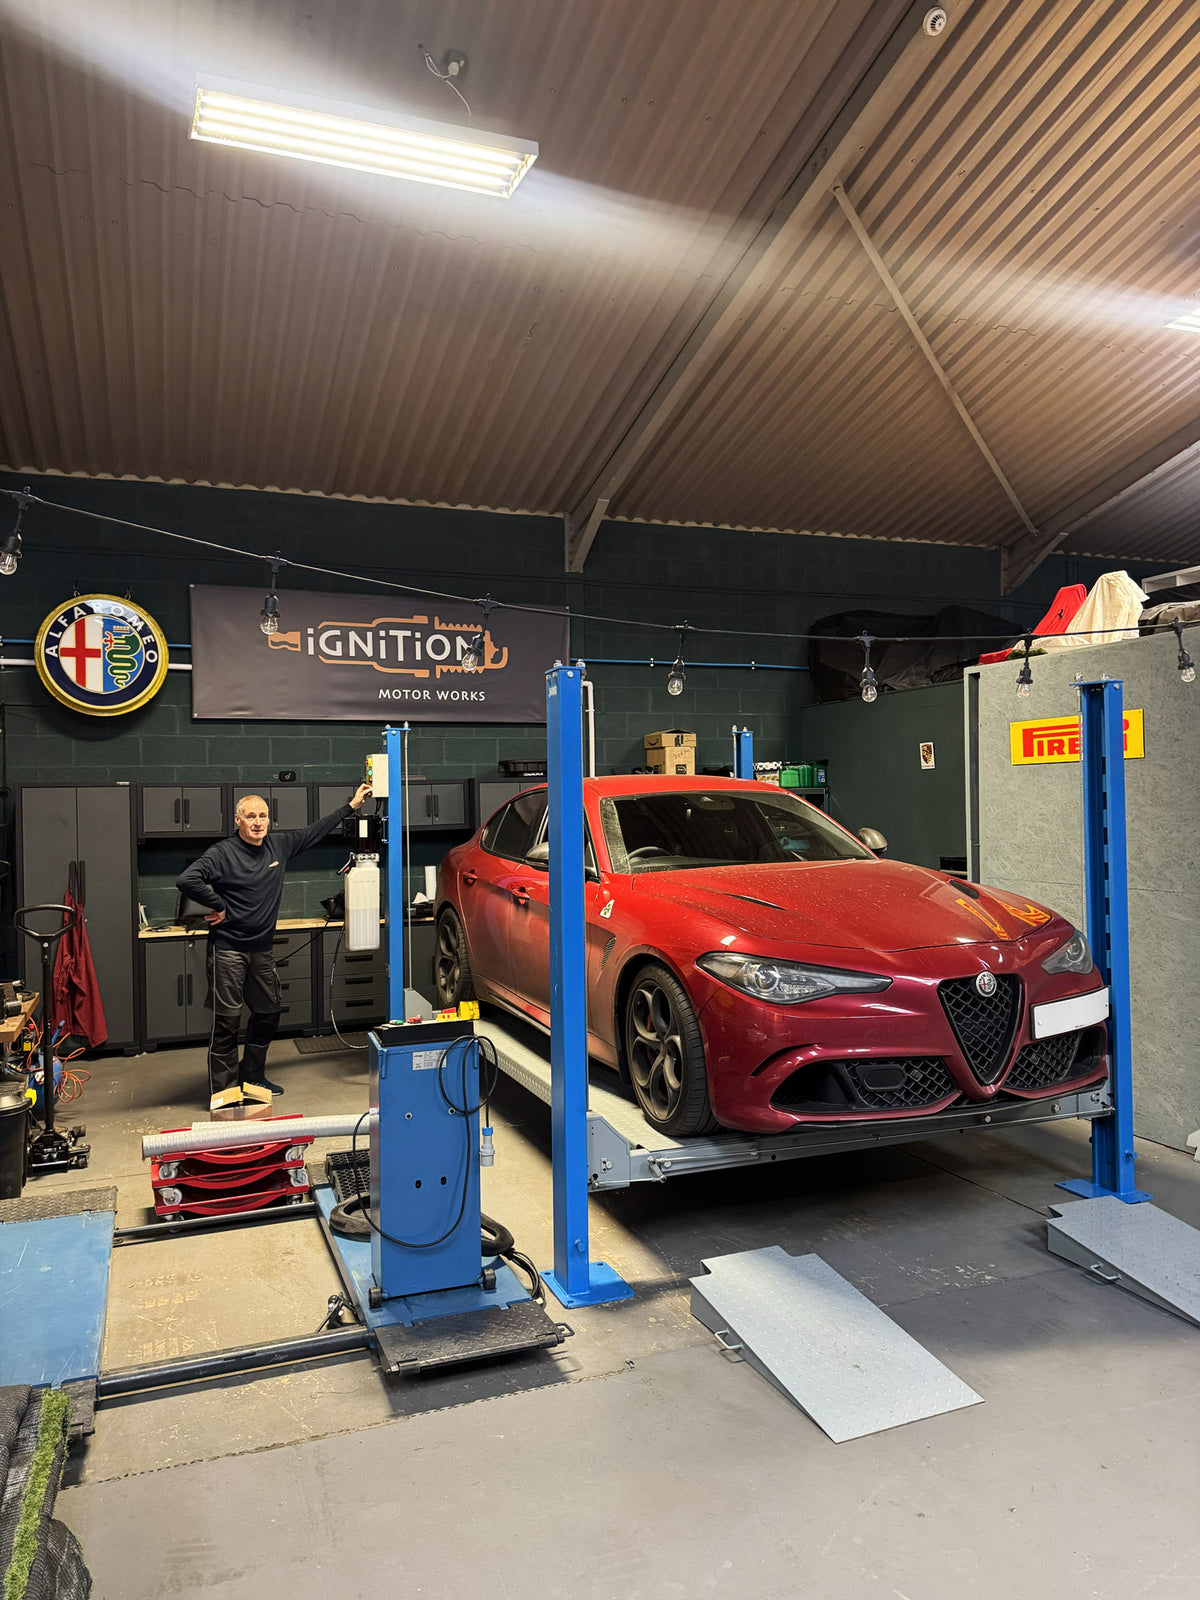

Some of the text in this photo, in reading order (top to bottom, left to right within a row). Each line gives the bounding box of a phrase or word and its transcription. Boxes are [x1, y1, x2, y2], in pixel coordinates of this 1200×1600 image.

[45, 602, 158, 663] ALFA ROMEO
[378, 688, 486, 701] MOTOR WORKS
